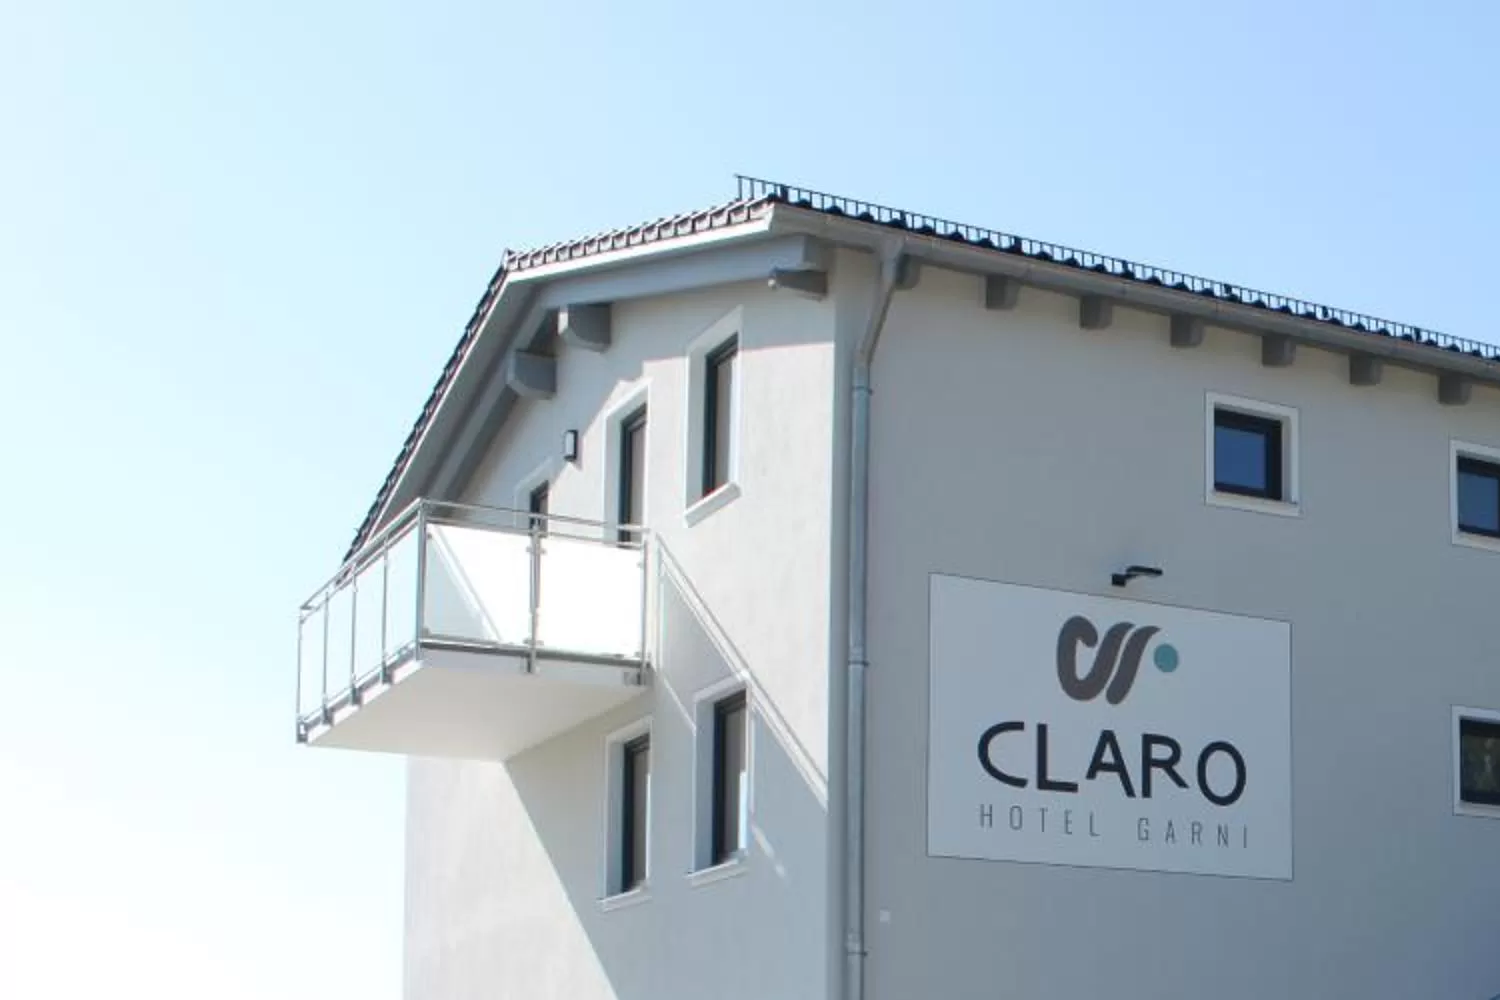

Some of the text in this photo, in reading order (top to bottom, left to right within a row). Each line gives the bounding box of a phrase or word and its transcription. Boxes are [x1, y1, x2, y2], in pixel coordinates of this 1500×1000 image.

[977, 721, 1247, 806] CLARO
[979, 803, 1248, 849] HOTEL GARNI
